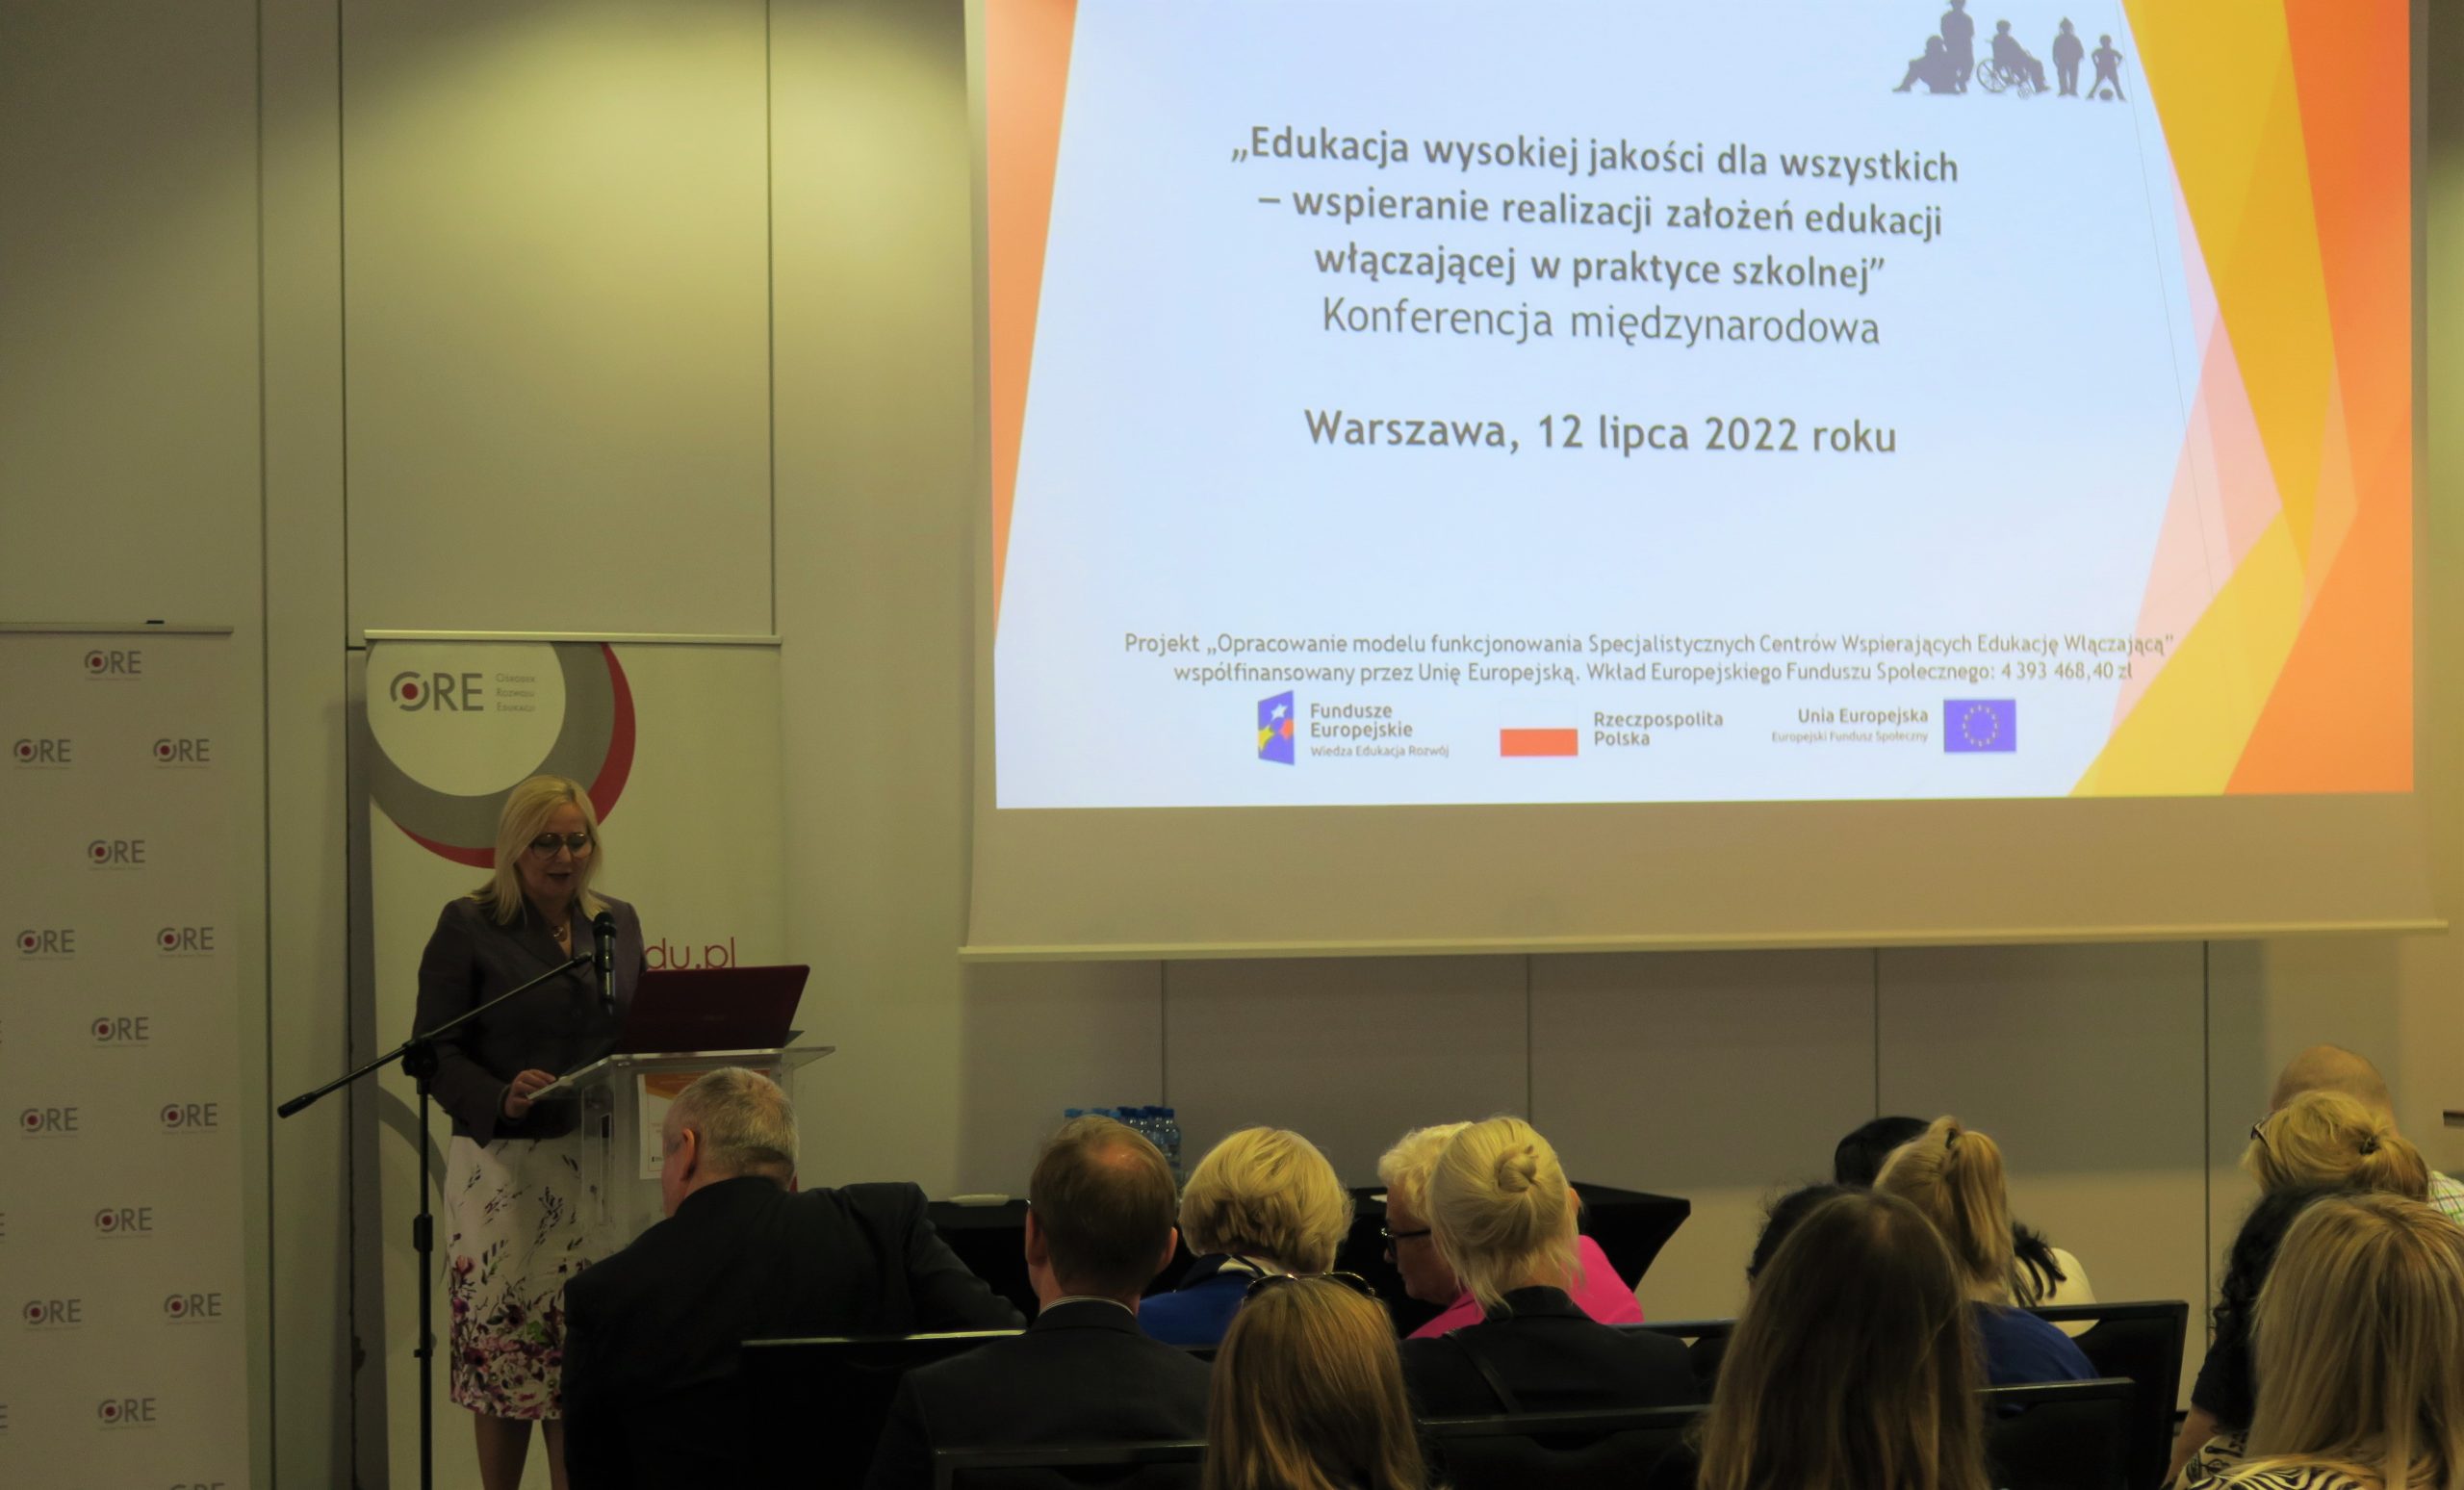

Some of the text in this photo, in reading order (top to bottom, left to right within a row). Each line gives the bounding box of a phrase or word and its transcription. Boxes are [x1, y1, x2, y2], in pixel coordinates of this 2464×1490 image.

[1232, 126, 1957, 184] „Edukacja wysokiej jakości dla wszystkich
[1293, 187, 1488, 224] wspieranie
[1503, 193, 1651, 234] realizacji
[1667, 197, 1792, 230] założeń
[1806, 202, 1940, 242] edukacji
[1315, 242, 1514, 286] włączającej
[1531, 257, 1560, 279] w
[1574, 250, 1720, 291] praktyce
[1324, 296, 1879, 348] Konferencja międzynarodowa
[1304, 410, 1895, 457] Warszawa, 12 lipca 2022 roku
[1126, 633, 1200, 656] Projekt
[1207, 633, 1348, 656] „Opracowanie
[1353, 634, 1425, 653] modelu
[1431, 634, 1582, 657] funkcjonowania
[1589, 634, 1755, 657] Specjalistycznych
[1759, 634, 1836, 653] Centrów
[1842, 635, 1971, 656] Wspierających
[1978, 634, 2059, 656] Edukację
[85, 650, 141, 674] ORE
[1361, 667, 1414, 685] przez
[1419, 663, 1460, 685] Unię
[1469, 662, 1579, 684] Europejską.
[1587, 662, 1646, 681] Wkład
[1652, 662, 1782, 683] Europejskiego
[1787, 662, 1871, 680] Funduszu
[2002, 662, 2011, 679] 4
[2017, 662, 2046, 679] 393
[2055, 662, 2113, 681] 468,40
[390, 672, 483, 711] ORE
[1311, 704, 1392, 718] Fundusze
[1595, 710, 1723, 729] Rzeczpospolita
[1799, 707, 1928, 725] Unia Europejska
[1311, 721, 1413, 740] Europejskie
[1595, 729, 1650, 746] Polska
[1772, 731, 1827, 744] Europejski
[1830, 731, 1872, 742] Fundusz
[13, 739, 71, 762] ORE
[153, 738, 210, 762] ORE
[1311, 745, 1449, 758] Wiedza Edukacja Rozwój
[88, 840, 145, 864] ORE
[16, 930, 74, 954] ORE
[157, 927, 214, 951] ORE
[645, 937, 735, 969] du.pl
[91, 1016, 148, 1041] ORE
[19, 1108, 78, 1133] ORE
[161, 1103, 218, 1128] ORE
[95, 1207, 152, 1233] ORE
[23, 1299, 81, 1324] ORE
[164, 1293, 221, 1318] ORE
[98, 1398, 156, 1424] ORE
